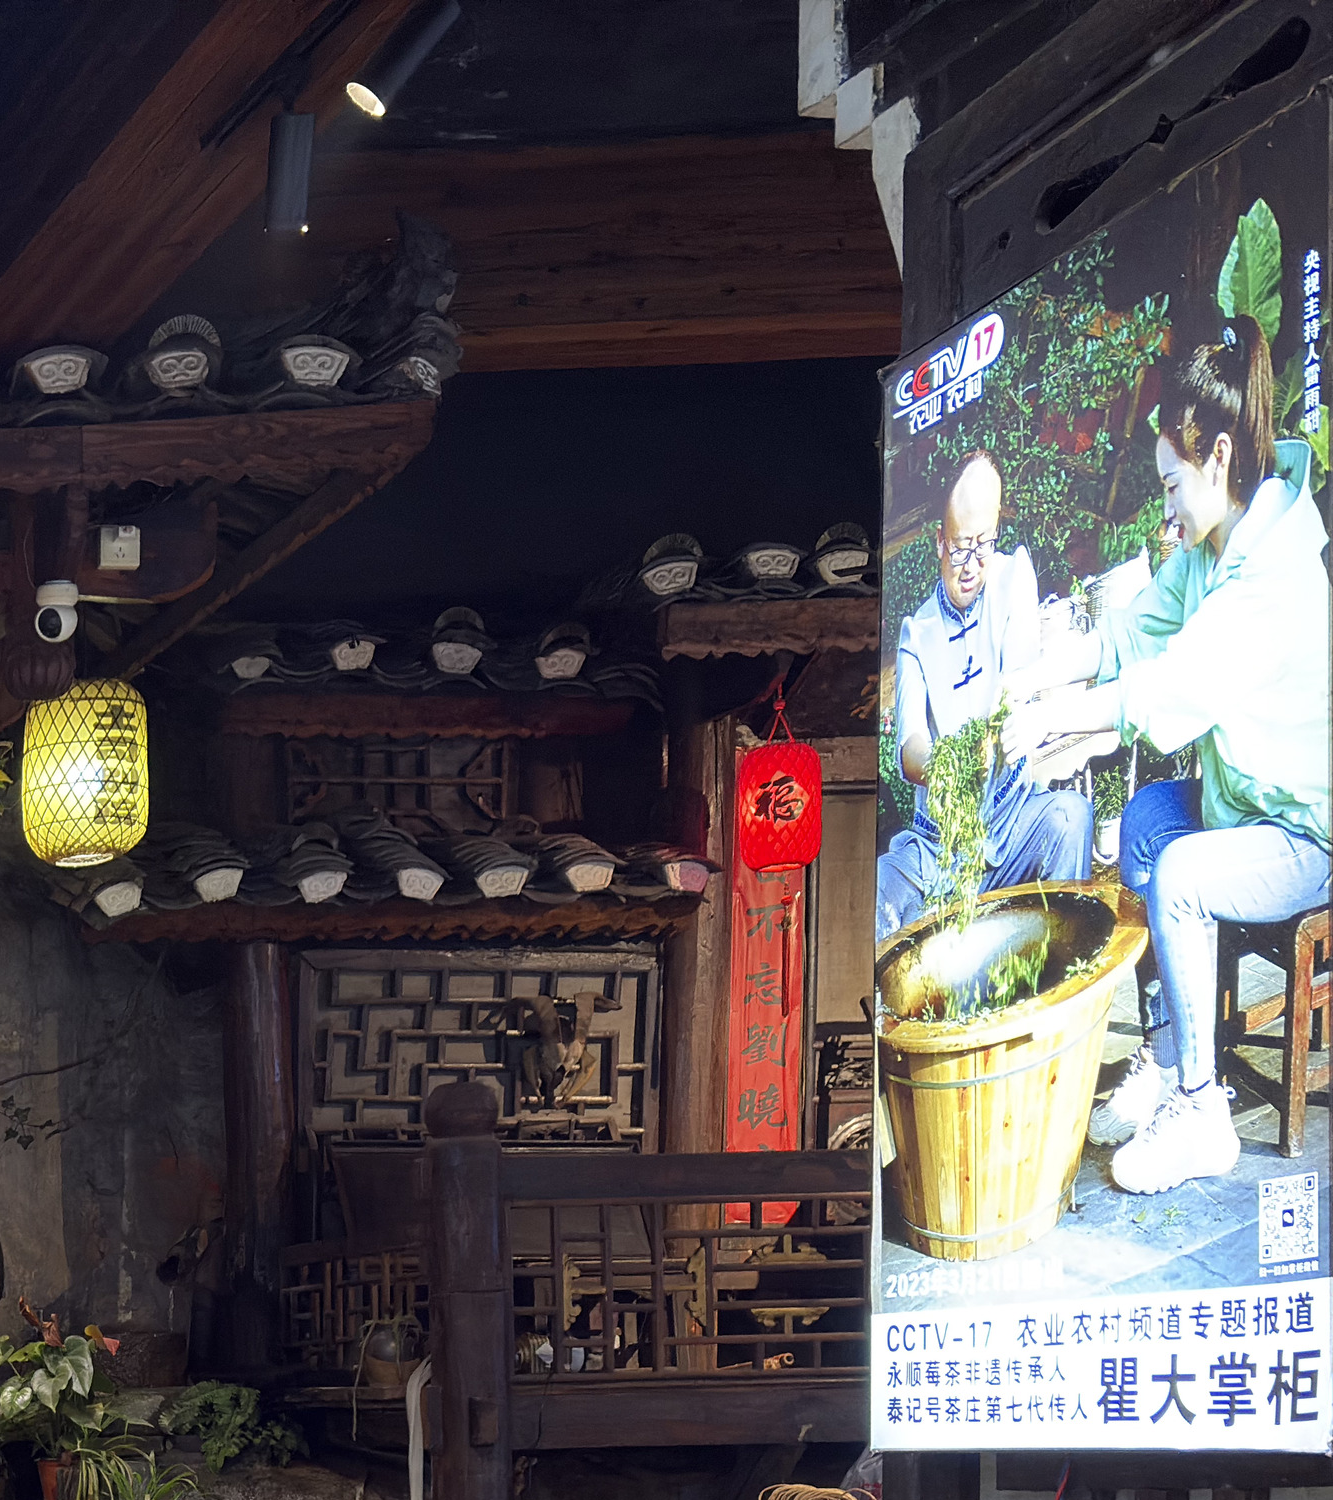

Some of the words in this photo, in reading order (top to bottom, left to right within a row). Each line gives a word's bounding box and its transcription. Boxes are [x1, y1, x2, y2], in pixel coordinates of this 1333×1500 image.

[1303, 249, 1322, 433] 央视主持人雷雨甜
[755, 776, 804, 821] 福
[887, 1320, 993, 1352] CCTV-17
[1016, 1291, 1315, 1349] 农业农村频道专题报道
[886, 1355, 1066, 1388] 永顺莓茶非遗传承人
[1097, 1348, 1322, 1427] 瞿大掌柜
[886, 1393, 1088, 1424] 泰记号茶庄第七代传人
